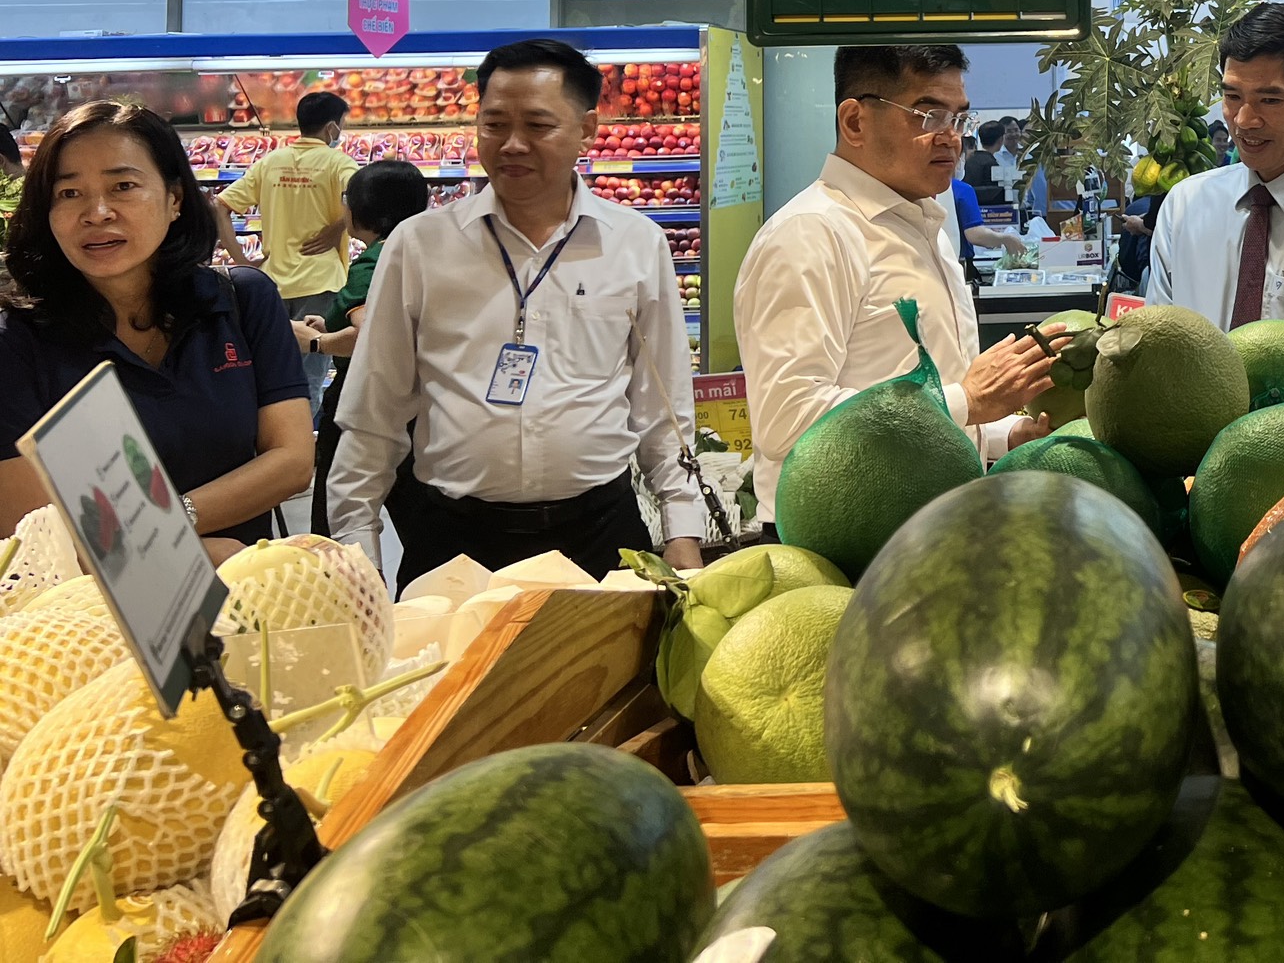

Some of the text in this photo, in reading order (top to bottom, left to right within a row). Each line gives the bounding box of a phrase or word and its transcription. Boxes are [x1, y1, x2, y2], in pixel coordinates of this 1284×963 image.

[708, 383, 737, 398] mãi
[728, 408, 747, 421] 74
[733, 439, 752, 451] 92
